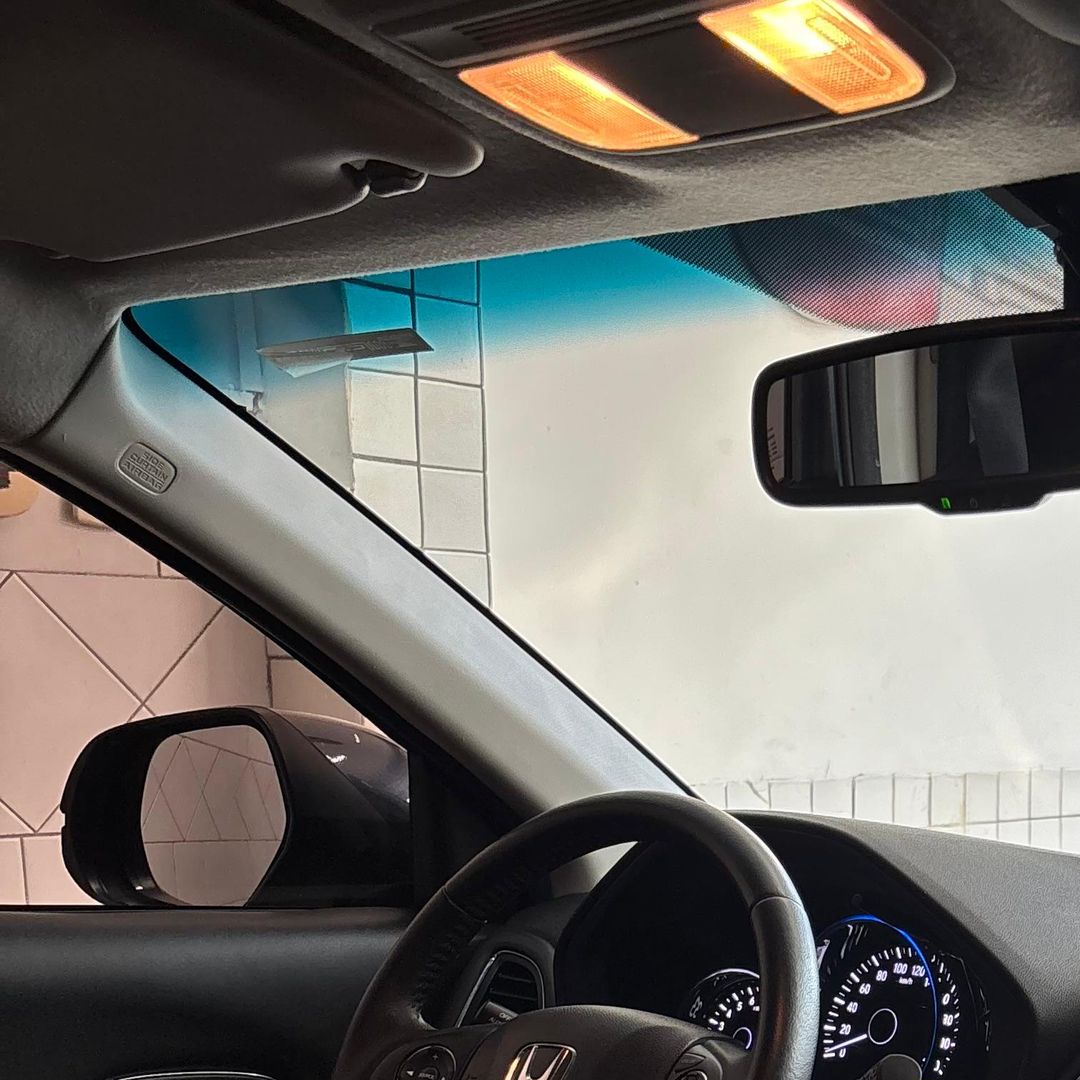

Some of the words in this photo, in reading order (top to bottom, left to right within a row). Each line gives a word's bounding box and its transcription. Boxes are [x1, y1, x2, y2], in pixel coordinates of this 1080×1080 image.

[142, 451, 165, 469] SIDE
[130, 453, 168, 480] CURTAIN
[122, 461, 163, 490] AIRBAG
[893, 963, 908, 974] 100
[912, 965, 926, 977] 120
[876, 970, 888, 982] 80
[859, 983, 871, 995] 60
[736, 1001, 743, 1012] 5
[748, 996, 755, 1006] 6
[847, 1001, 858, 1013] 40
[840, 1024, 851, 1035] 20
[840, 1048, 846, 1058] 0
